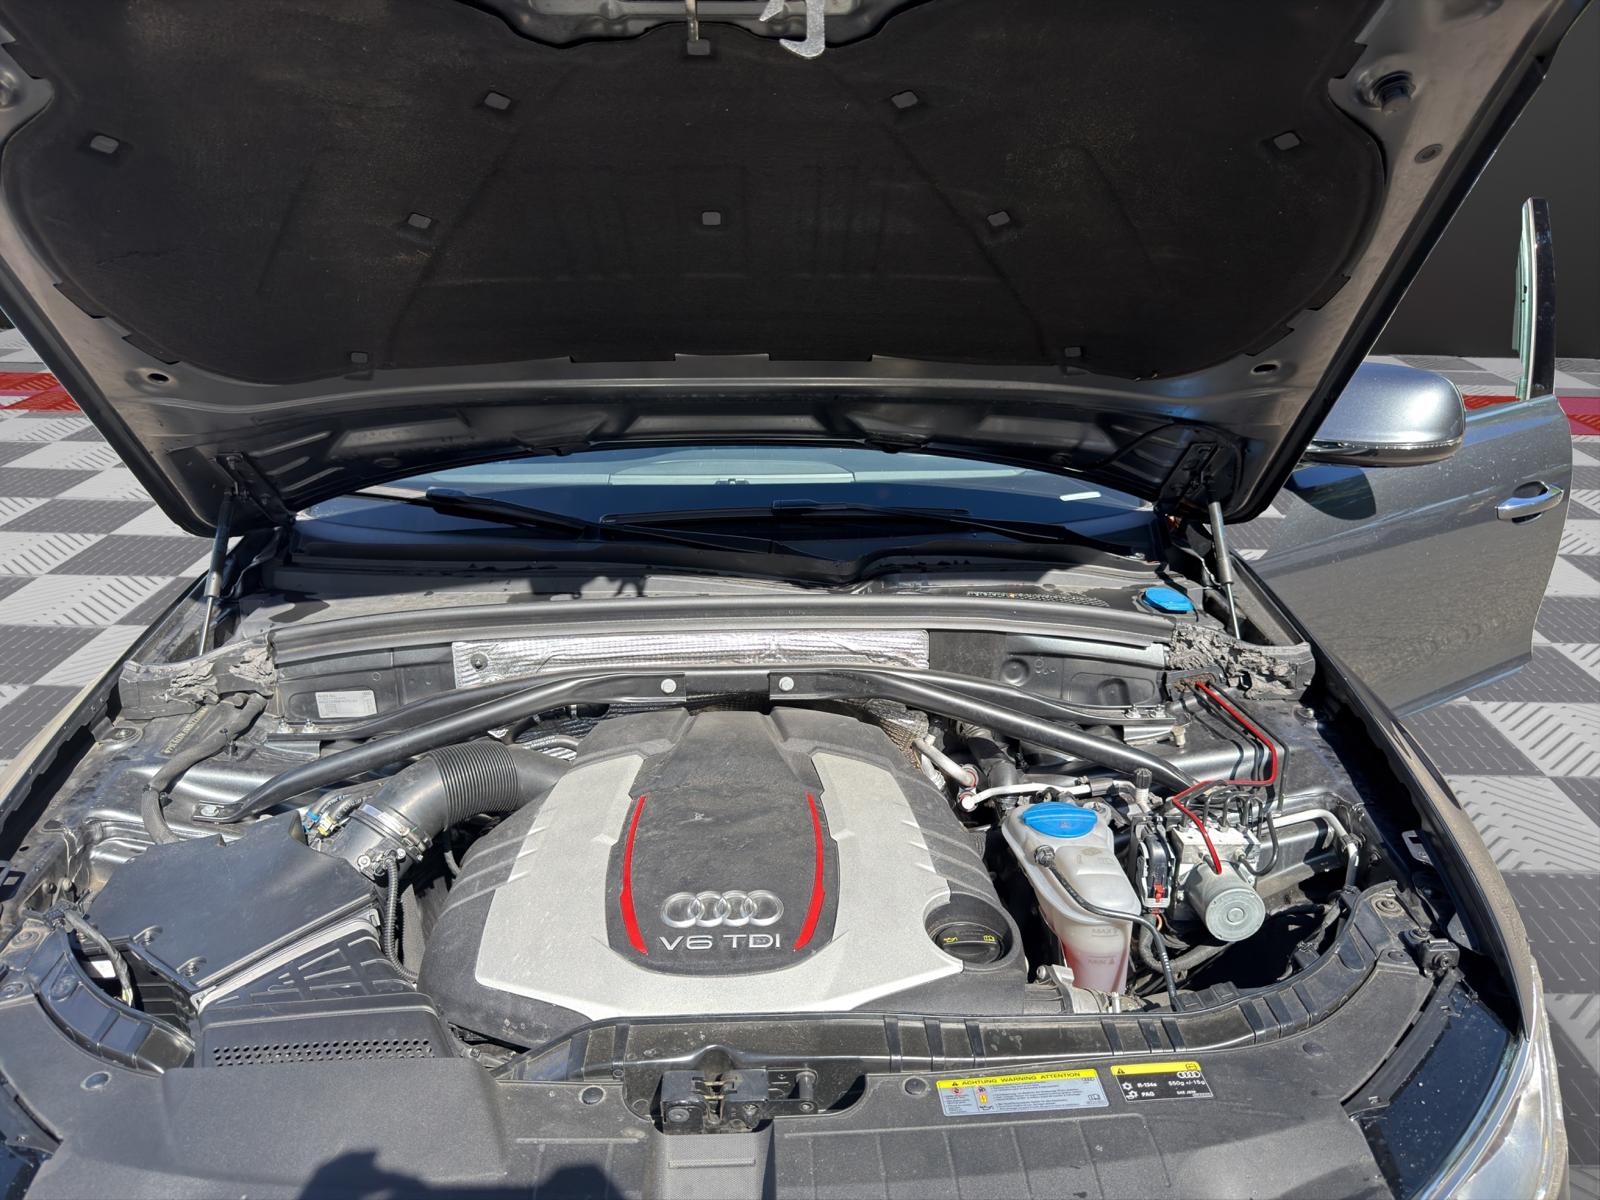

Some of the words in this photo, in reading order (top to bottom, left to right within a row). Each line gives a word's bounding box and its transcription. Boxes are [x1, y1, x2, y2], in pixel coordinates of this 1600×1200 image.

[659, 934, 713, 951] V6
[722, 933, 780, 949] TDI
[962, 1078, 997, 1087] ACHTUNG
[1001, 1075, 1037, 1083] WARNING
[1040, 1072, 1081, 1080] ATTENTION
